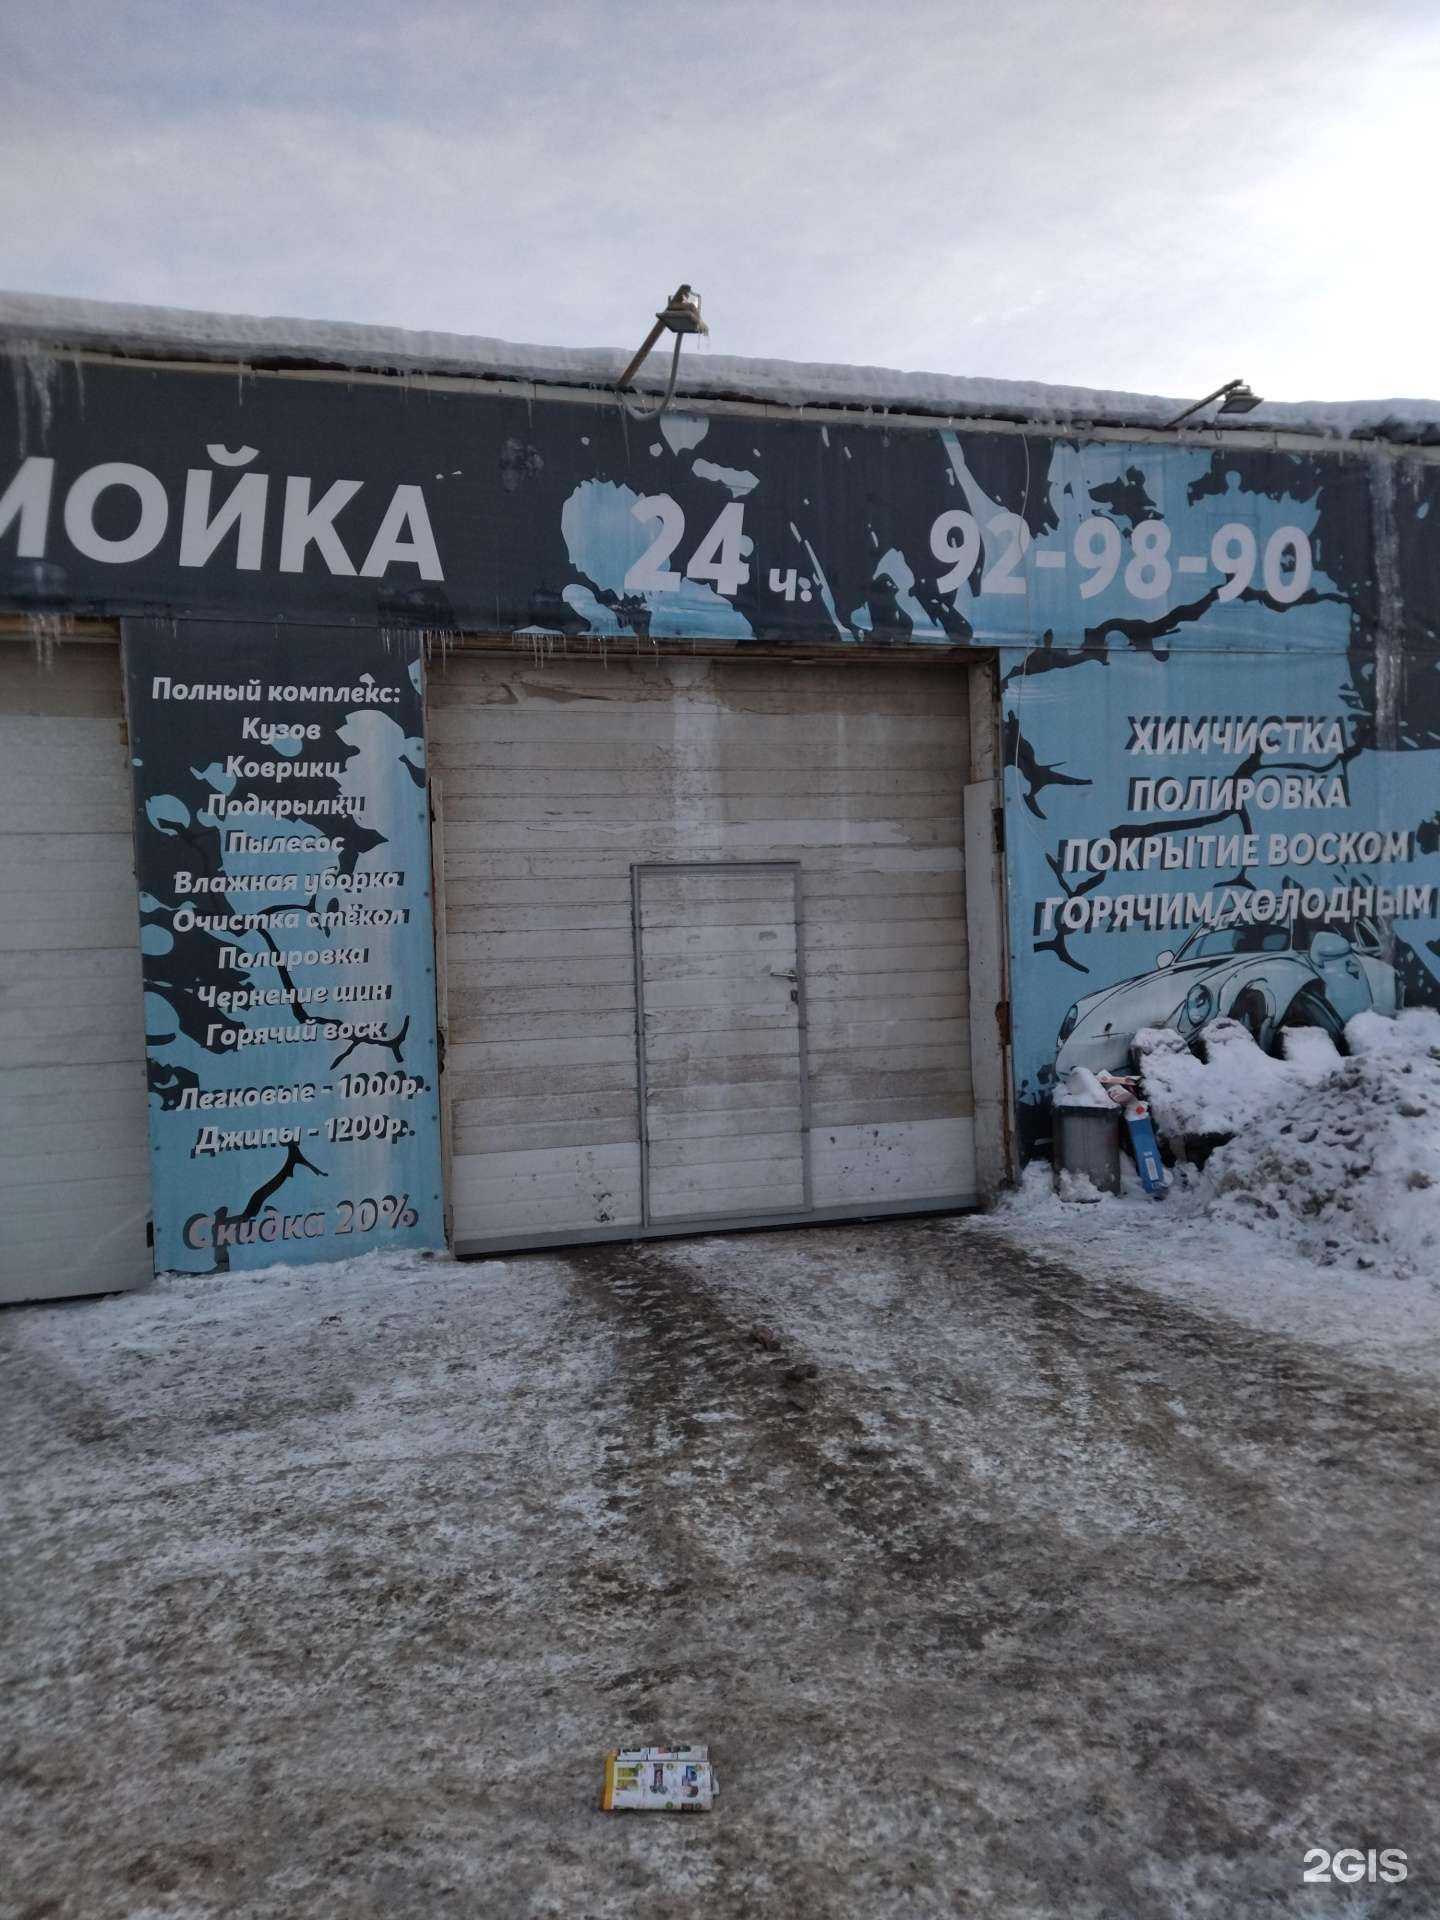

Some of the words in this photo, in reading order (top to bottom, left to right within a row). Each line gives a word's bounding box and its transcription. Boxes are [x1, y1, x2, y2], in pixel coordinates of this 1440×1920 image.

[623, 492, 747, 596] 24
[930, 509, 1312, 603] 92-98-90
[152, 677, 261, 701] Полный
[267, 682, 401, 703] комплекс:
[241, 717, 321, 744] Кузов
[1128, 719, 1346, 756] ХИМЧИСТКА
[226, 755, 340, 783] Коврики
[207, 793, 365, 821] Подкрылки
[1131, 776, 1349, 813] ПОЛИРОВКА
[228, 831, 345, 854] Пылесос
[1062, 834, 1260, 873] ПОКРЫТИЕ
[1267, 832, 1413, 868] ВОСКОМ
[174, 871, 298, 893] Влажная
[303, 869, 401, 896] уборка
[172, 909, 299, 932] Очистка
[306, 904, 406, 926] стёкол
[218, 946, 367, 970] Полировка
[197, 985, 328, 1012] Чернение
[332, 984, 392, 1000] шин
[206, 1019, 318, 1049] Горячий
[323, 1022, 388, 1039] воск
[176, 1086, 315, 1111] Легковые
[338, 1074, 425, 1099] 1000р.
[194, 1125, 301, 1155] Джипы
[326, 1116, 412, 1142] 1200р.
[185, 1209, 325, 1249] Скидка
[335, 1196, 418, 1236] 20%
